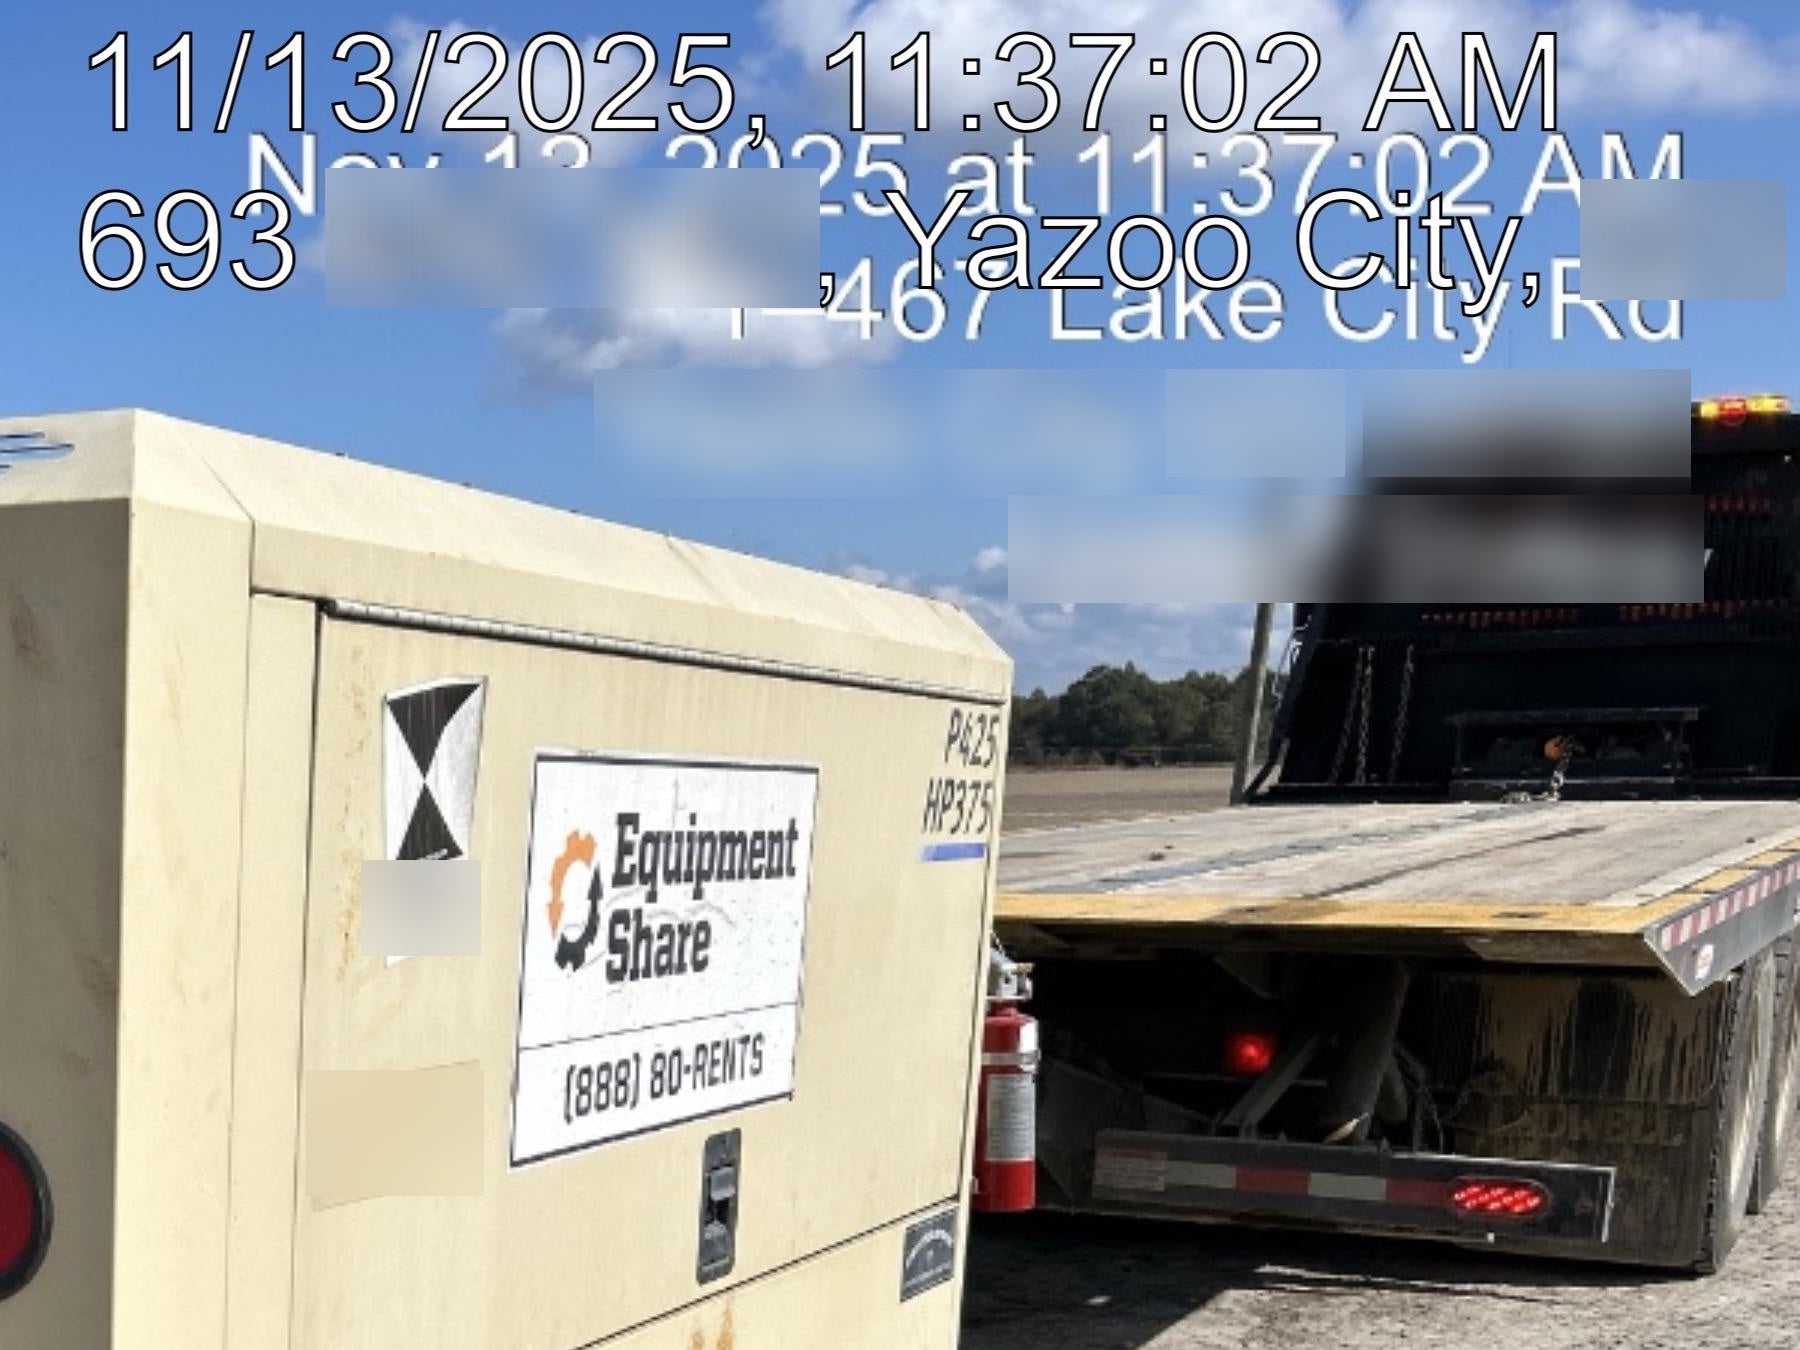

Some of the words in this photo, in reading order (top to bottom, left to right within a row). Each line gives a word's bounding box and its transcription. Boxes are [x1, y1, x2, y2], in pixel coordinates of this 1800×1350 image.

[945, 707, 1000, 769] P425
[921, 776, 994, 835] HP375
[611, 812, 799, 904] Equipment
[605, 907, 712, 985] Share
[563, 1051, 641, 1126] (888)
[649, 1031, 766, 1100] 80-RENTS
